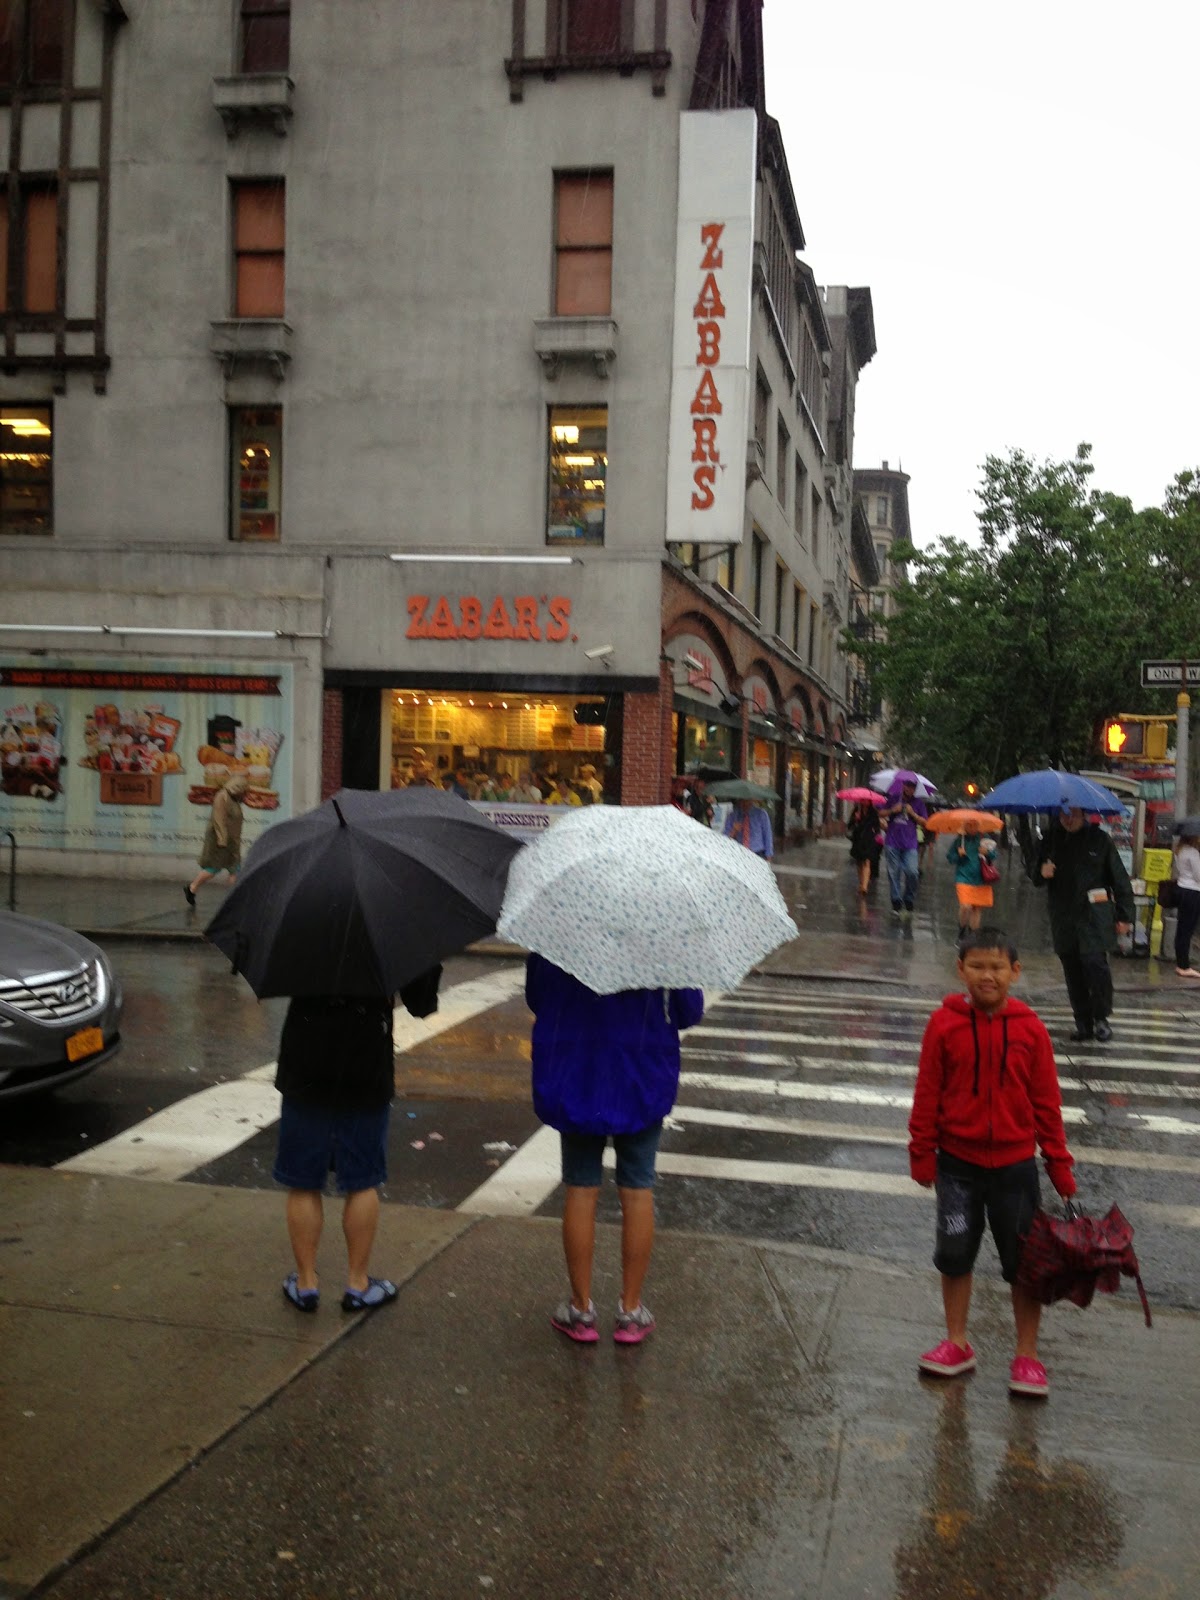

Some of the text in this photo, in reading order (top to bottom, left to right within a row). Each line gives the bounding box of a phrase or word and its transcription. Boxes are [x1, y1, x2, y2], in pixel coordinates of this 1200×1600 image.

[691, 222, 727, 511] ZABAR'S
[405, 594, 573, 642] ZABAR'S
[1154, 667, 1178, 680] ONE
